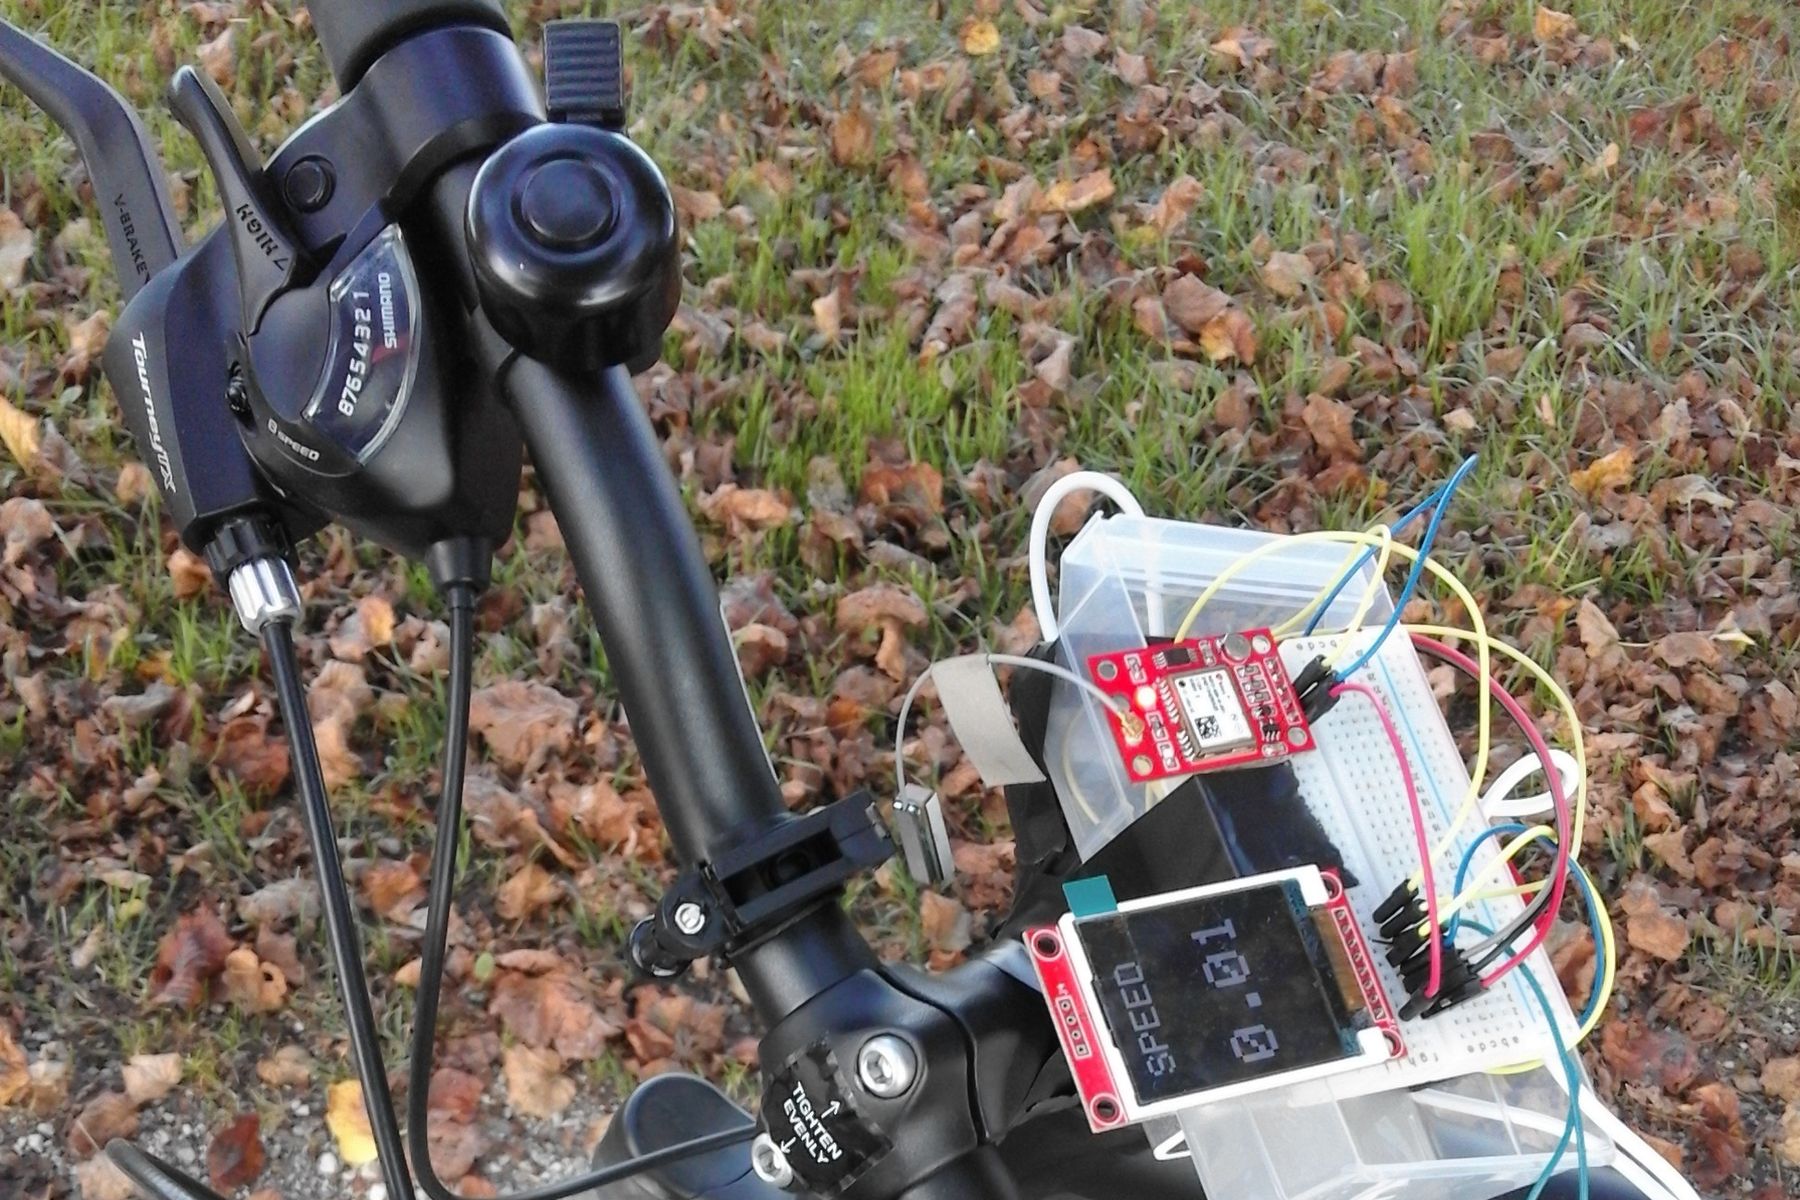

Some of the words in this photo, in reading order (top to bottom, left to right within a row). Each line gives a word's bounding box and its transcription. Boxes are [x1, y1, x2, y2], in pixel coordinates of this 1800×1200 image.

[378, 272, 397, 349] SHIMANO
[1114, 961, 1176, 1077] SPEED
[1190, 918, 1279, 1063] 0.01
[783, 1098, 829, 1163] EVENLY
[792, 1081, 843, 1161] TIGHTEN
